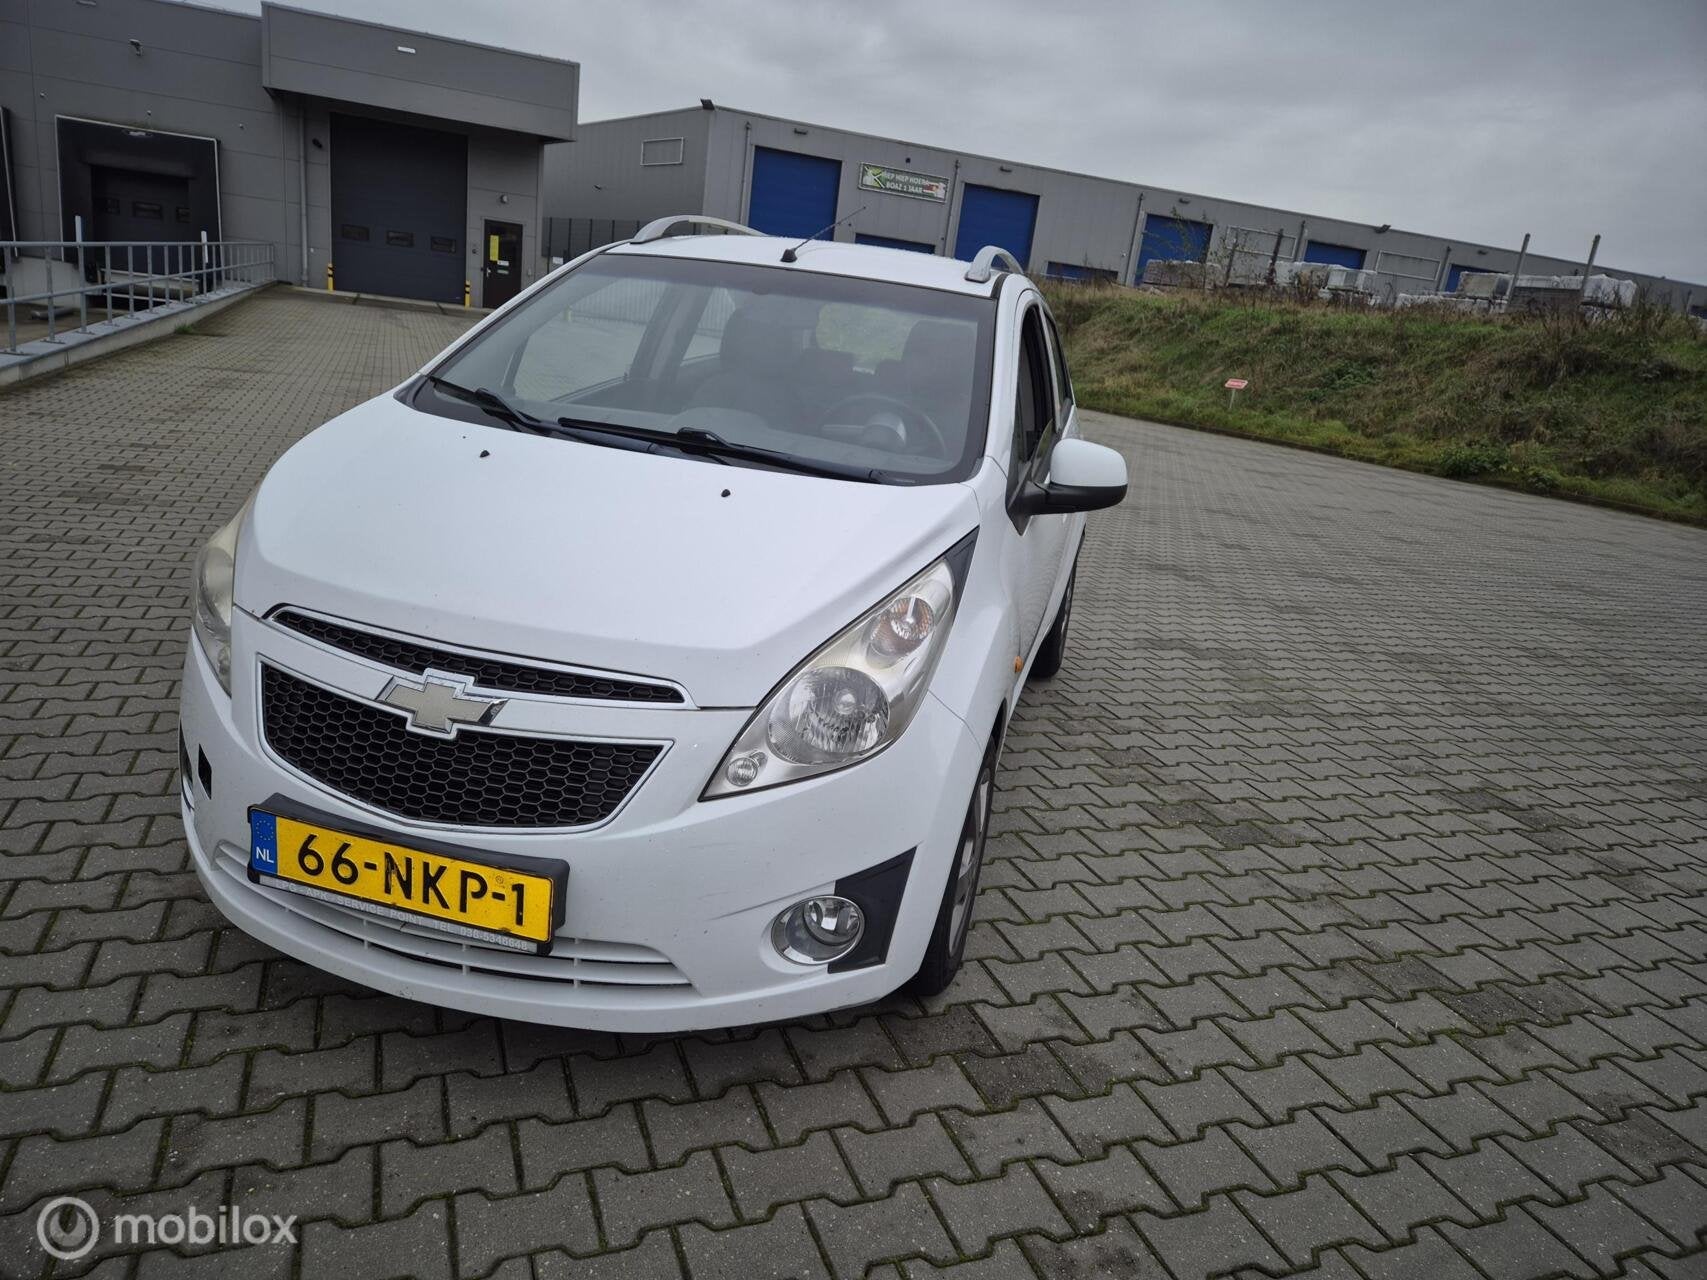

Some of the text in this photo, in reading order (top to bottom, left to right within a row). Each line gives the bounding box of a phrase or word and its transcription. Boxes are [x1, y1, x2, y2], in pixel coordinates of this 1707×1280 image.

[255, 846, 275, 864] NL
[297, 833, 525, 927] 66-NKP-1
[336, 896, 385, 916] SERVICE
[390, 909, 423, 925] POINT
